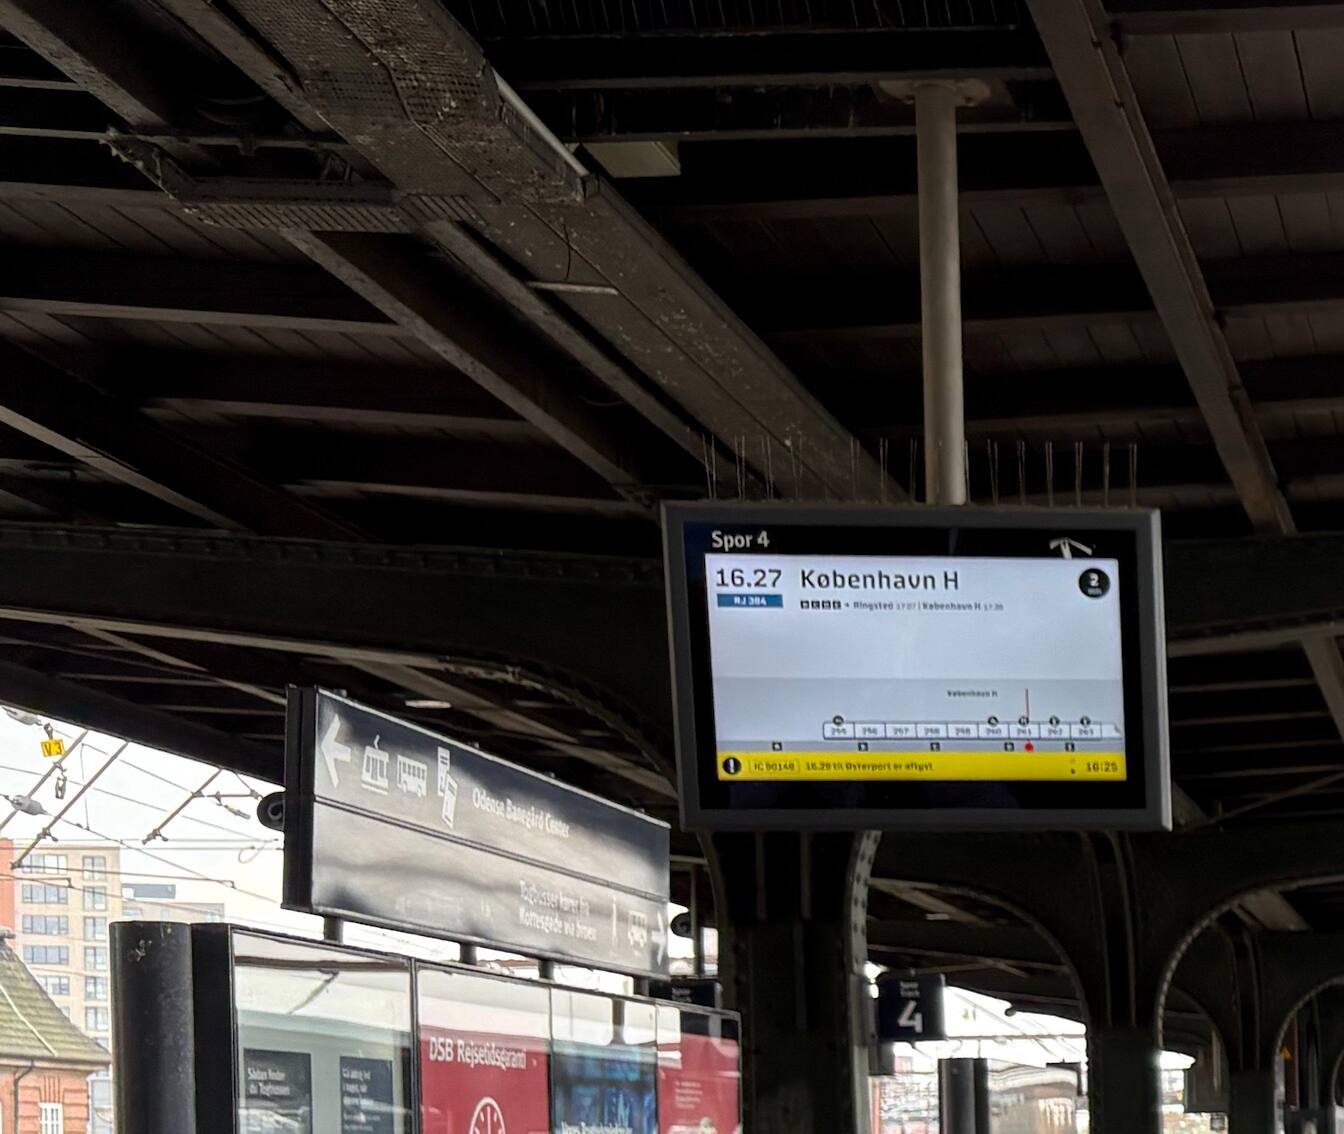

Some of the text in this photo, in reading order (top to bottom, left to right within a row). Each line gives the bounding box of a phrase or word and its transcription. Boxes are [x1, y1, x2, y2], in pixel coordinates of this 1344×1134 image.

[712, 530, 770, 552] Spor 4
[716, 568, 960, 590] 16.27 København H
[853, 600, 894, 612] Ringsted
[922, 601, 972, 610] København
[1086, 762, 1118, 772] 16:25
[472, 786, 505, 817] Odense
[899, 1000, 923, 1033] 4
[429, 1036, 454, 1062] DSB
